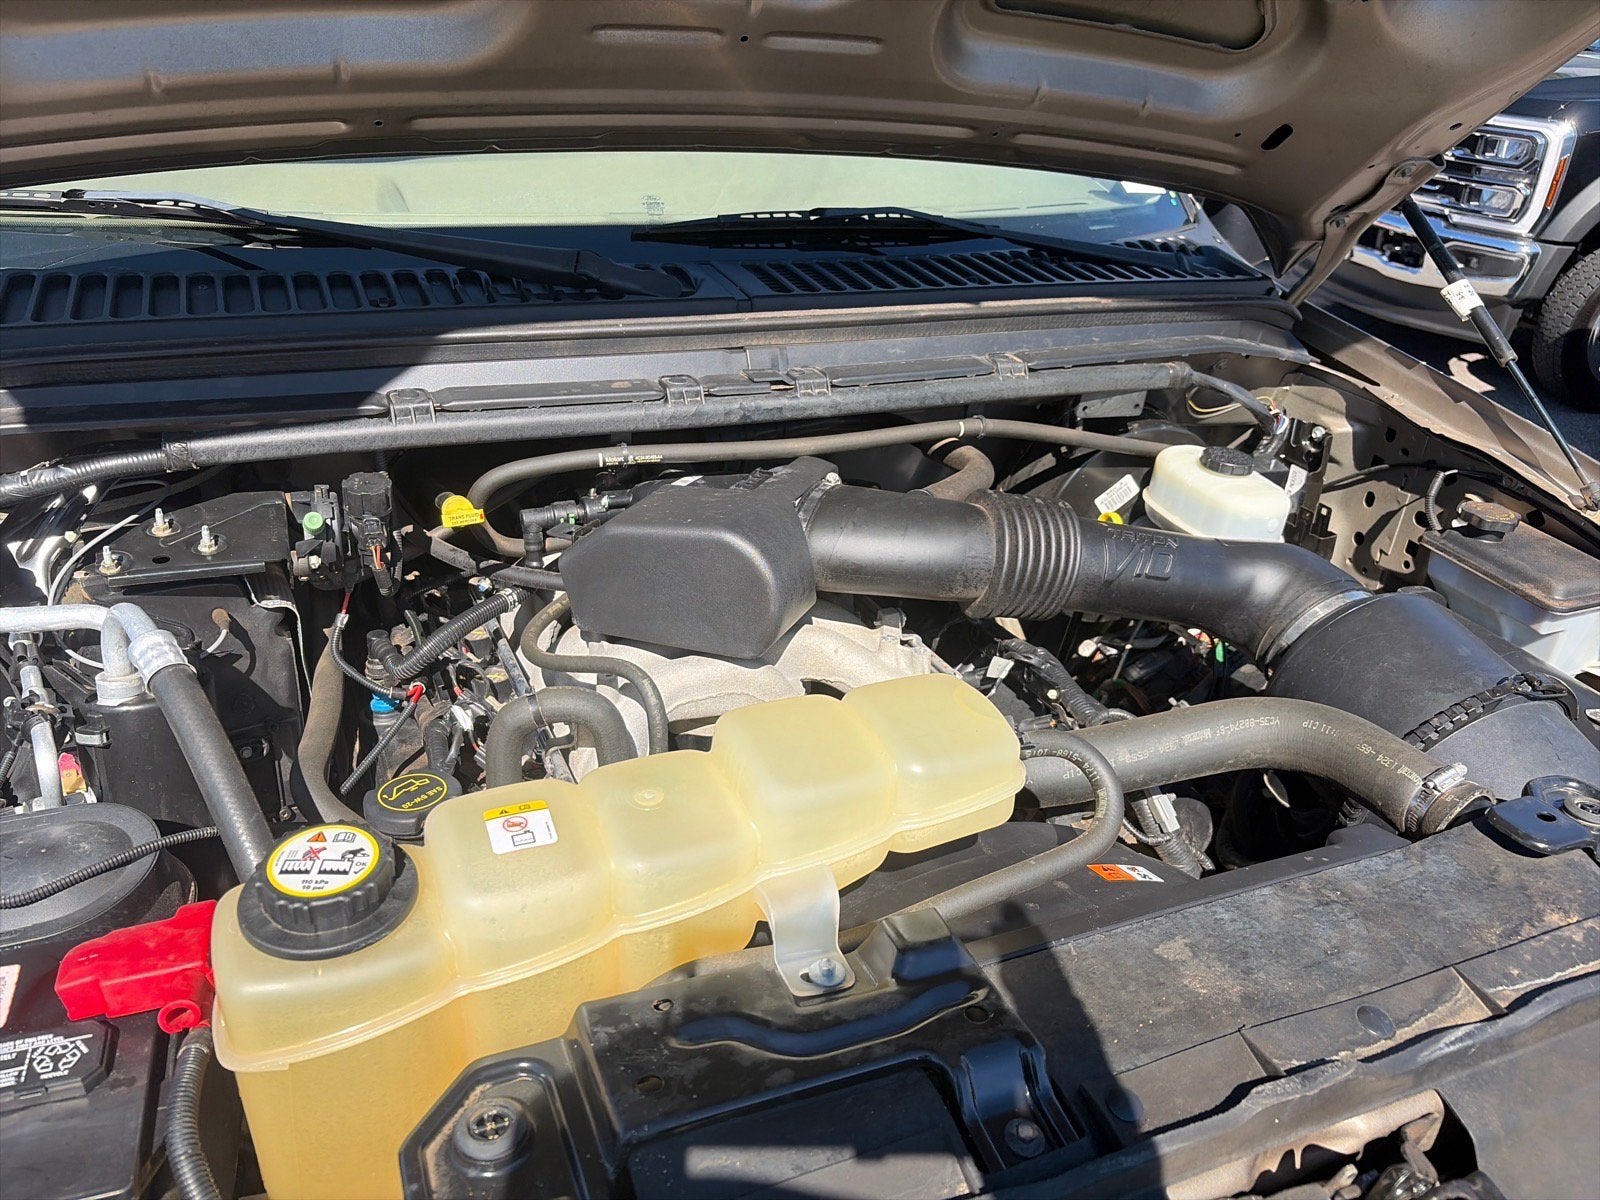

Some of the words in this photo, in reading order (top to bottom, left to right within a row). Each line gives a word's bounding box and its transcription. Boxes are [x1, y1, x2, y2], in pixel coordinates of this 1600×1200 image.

[447, 514, 466, 522] TRANS
[1106, 527, 1179, 549] TRITON
[1102, 538, 1175, 584] V10
[426, 786, 443, 797] SAE
